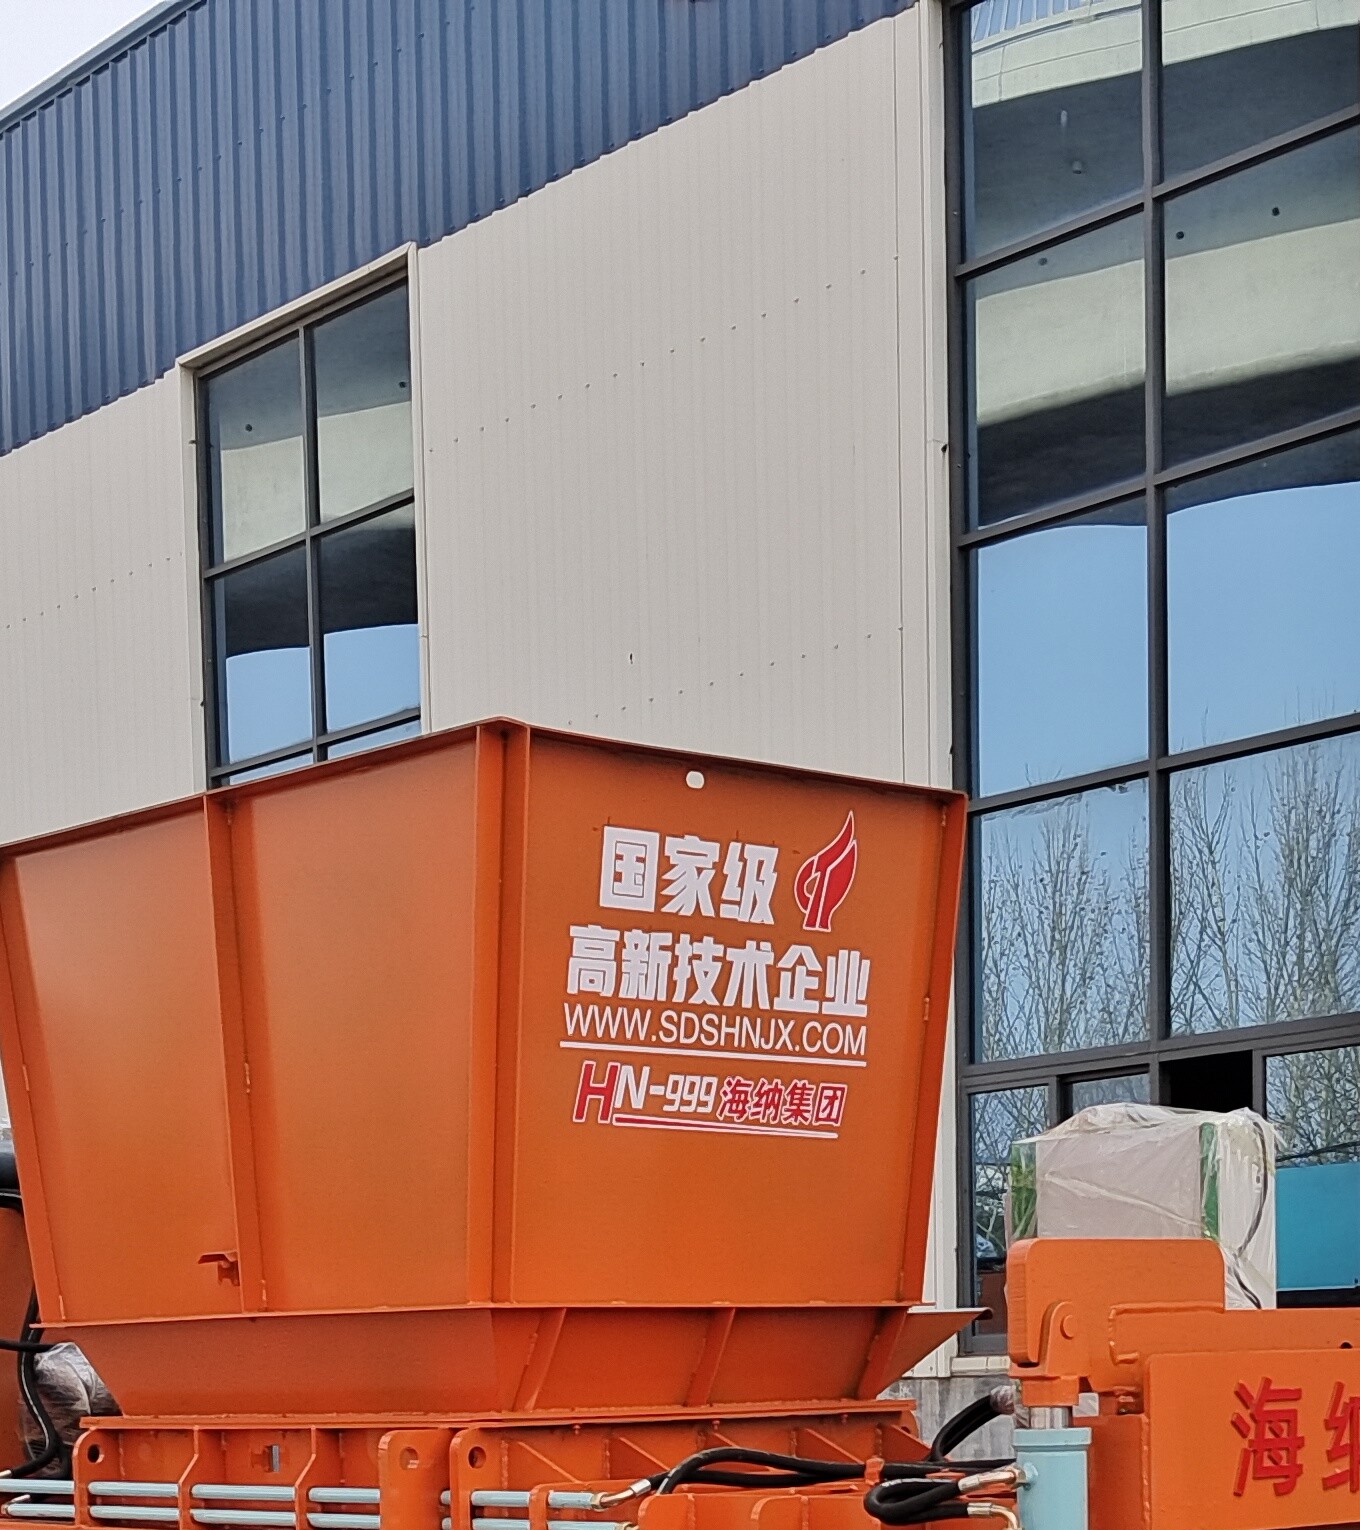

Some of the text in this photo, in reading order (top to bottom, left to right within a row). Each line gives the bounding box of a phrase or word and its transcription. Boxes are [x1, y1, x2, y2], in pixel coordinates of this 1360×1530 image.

[600, 825, 778, 924] 国家级
[566, 924, 870, 1017] 高新技术企业
[564, 1003, 866, 1055] WWW.SDSHNJX.COM
